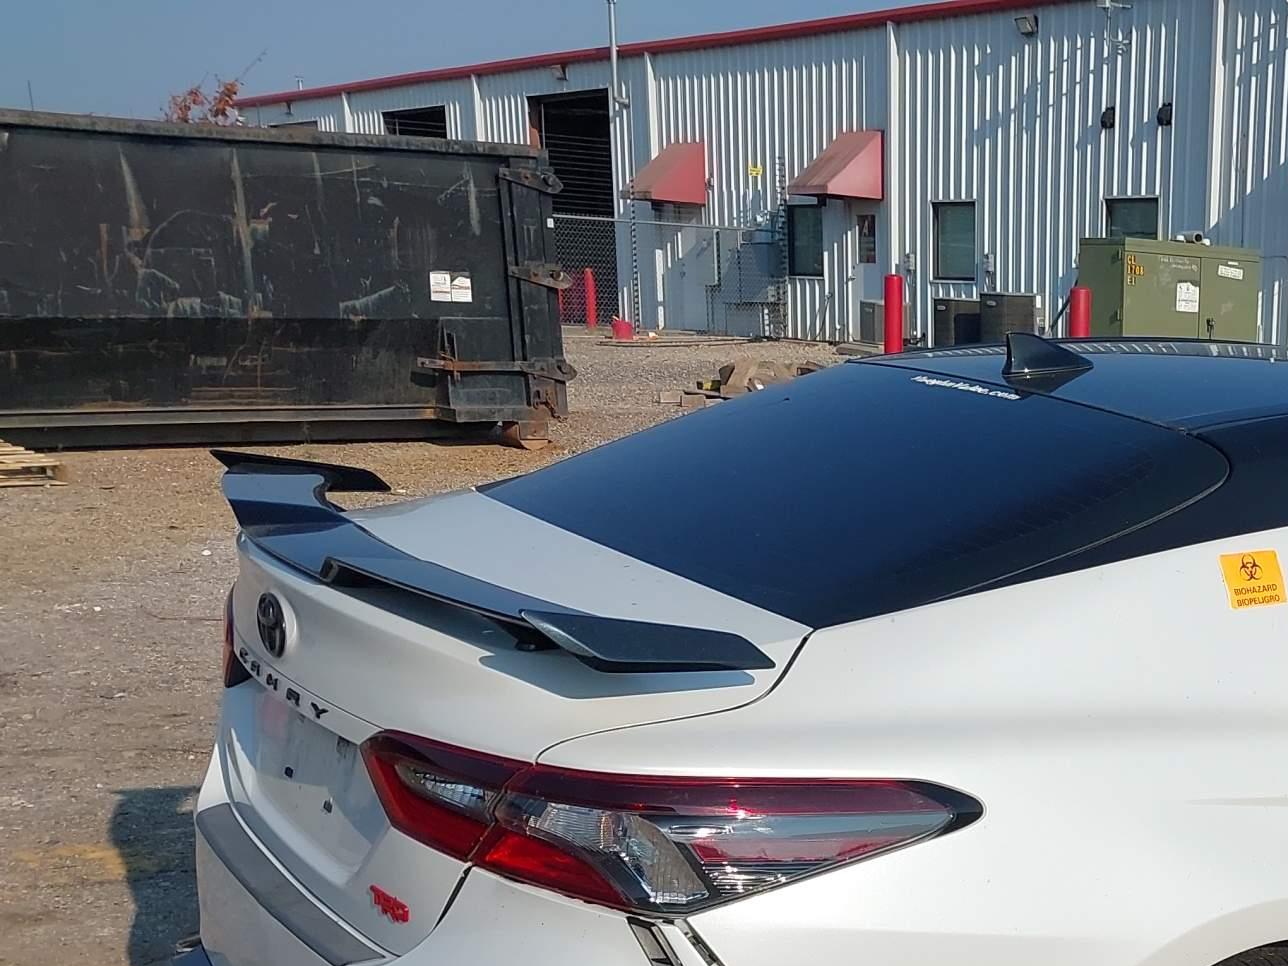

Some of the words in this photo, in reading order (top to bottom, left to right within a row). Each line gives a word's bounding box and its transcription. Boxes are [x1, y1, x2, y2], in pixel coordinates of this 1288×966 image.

[1127, 255, 1136, 265] CL
[1127, 264, 1145, 276] 1708
[1233, 583, 1278, 597] BIOHAZARD
[1236, 594, 1281, 607] BIOPELIGRO
[239, 646, 329, 720] CAMRY
[369, 884, 410, 923] TRD
